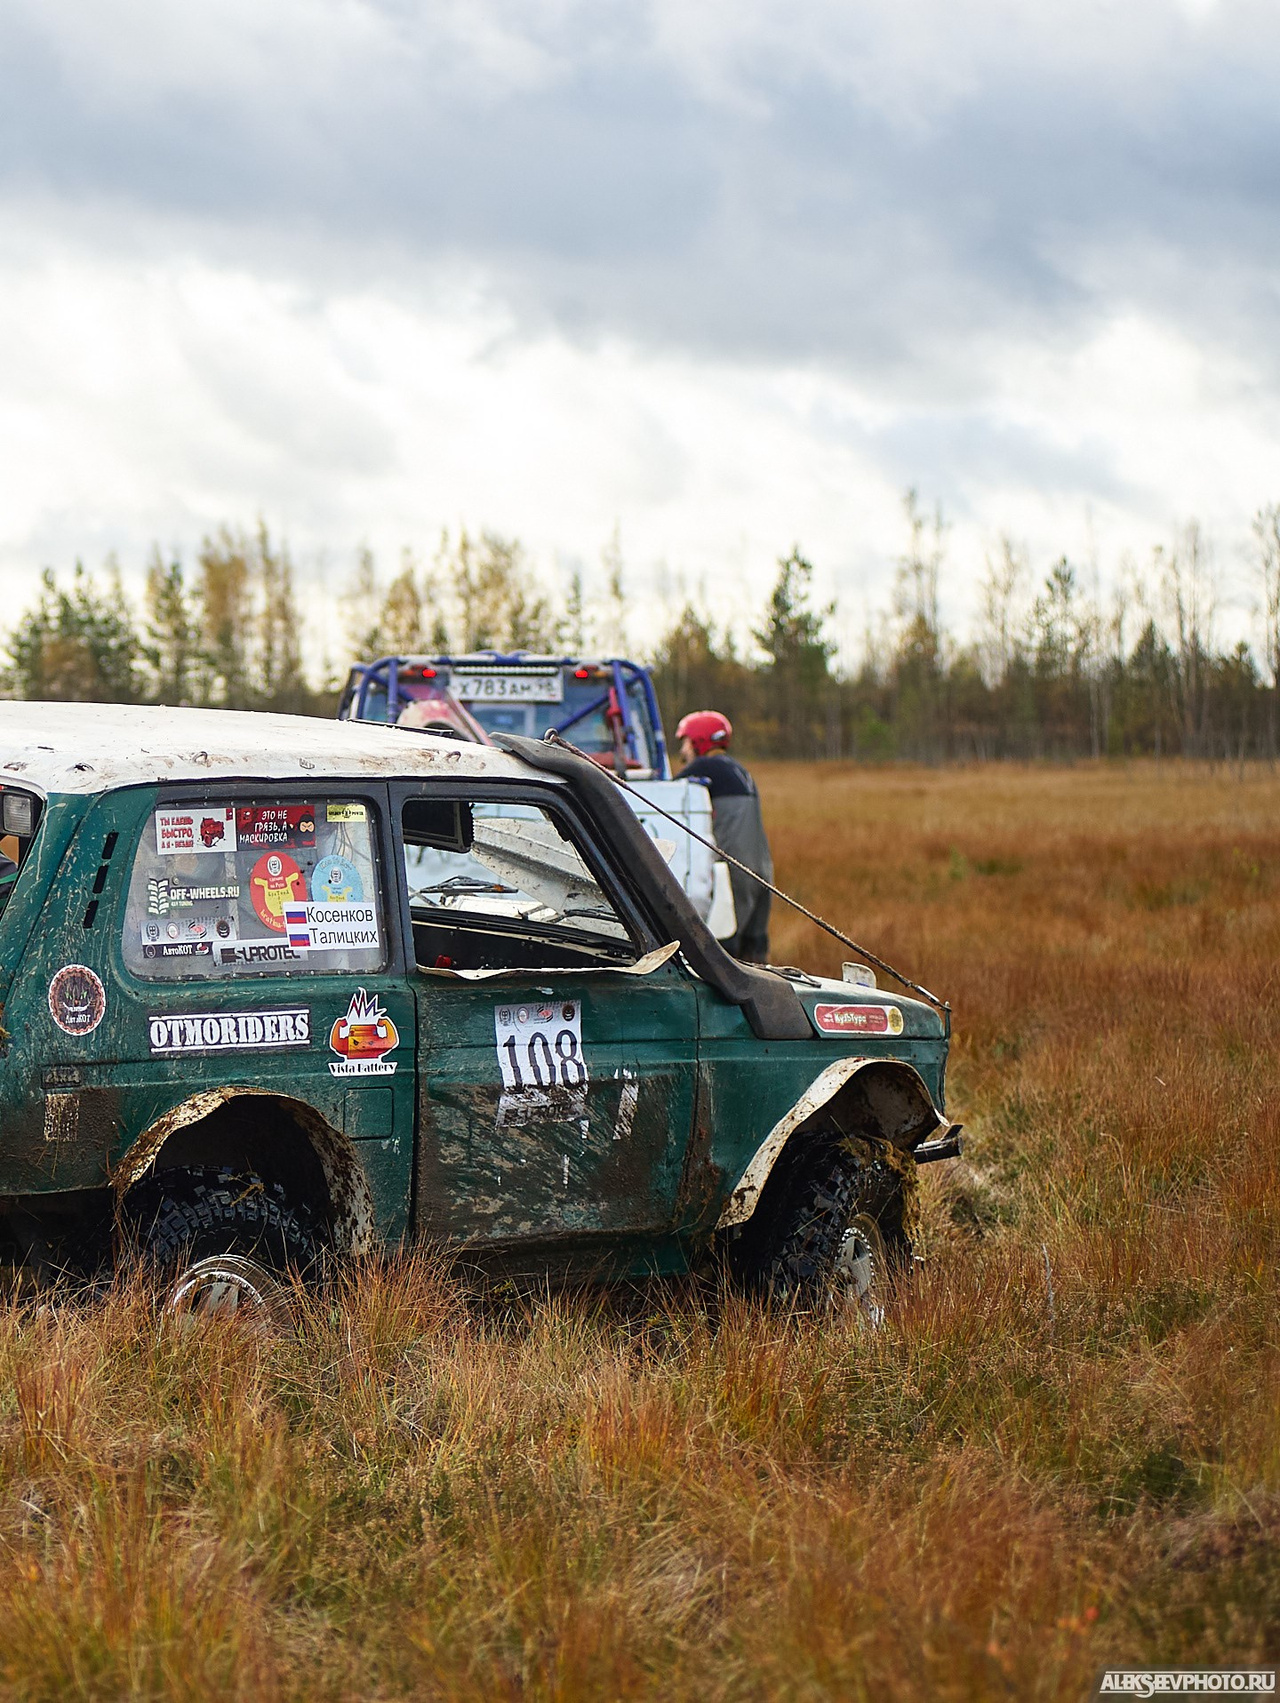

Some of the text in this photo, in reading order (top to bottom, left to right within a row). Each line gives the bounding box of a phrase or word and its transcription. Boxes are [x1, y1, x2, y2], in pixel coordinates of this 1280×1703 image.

[261, 810, 288, 820] ЭТО НЕ
[254, 821, 281, 832] ГРЯЗЬ,
[239, 832, 288, 844] МАСКИРОВКА
[170, 886, 240, 900] OFF-WHEELS.RU
[306, 906, 374, 923] Косенков
[308, 927, 378, 946] Талицких
[150, 1013, 310, 1048] OTMORIDERS
[330, 1063, 356, 1074] Vista
[503, 1029, 586, 1094] 108
